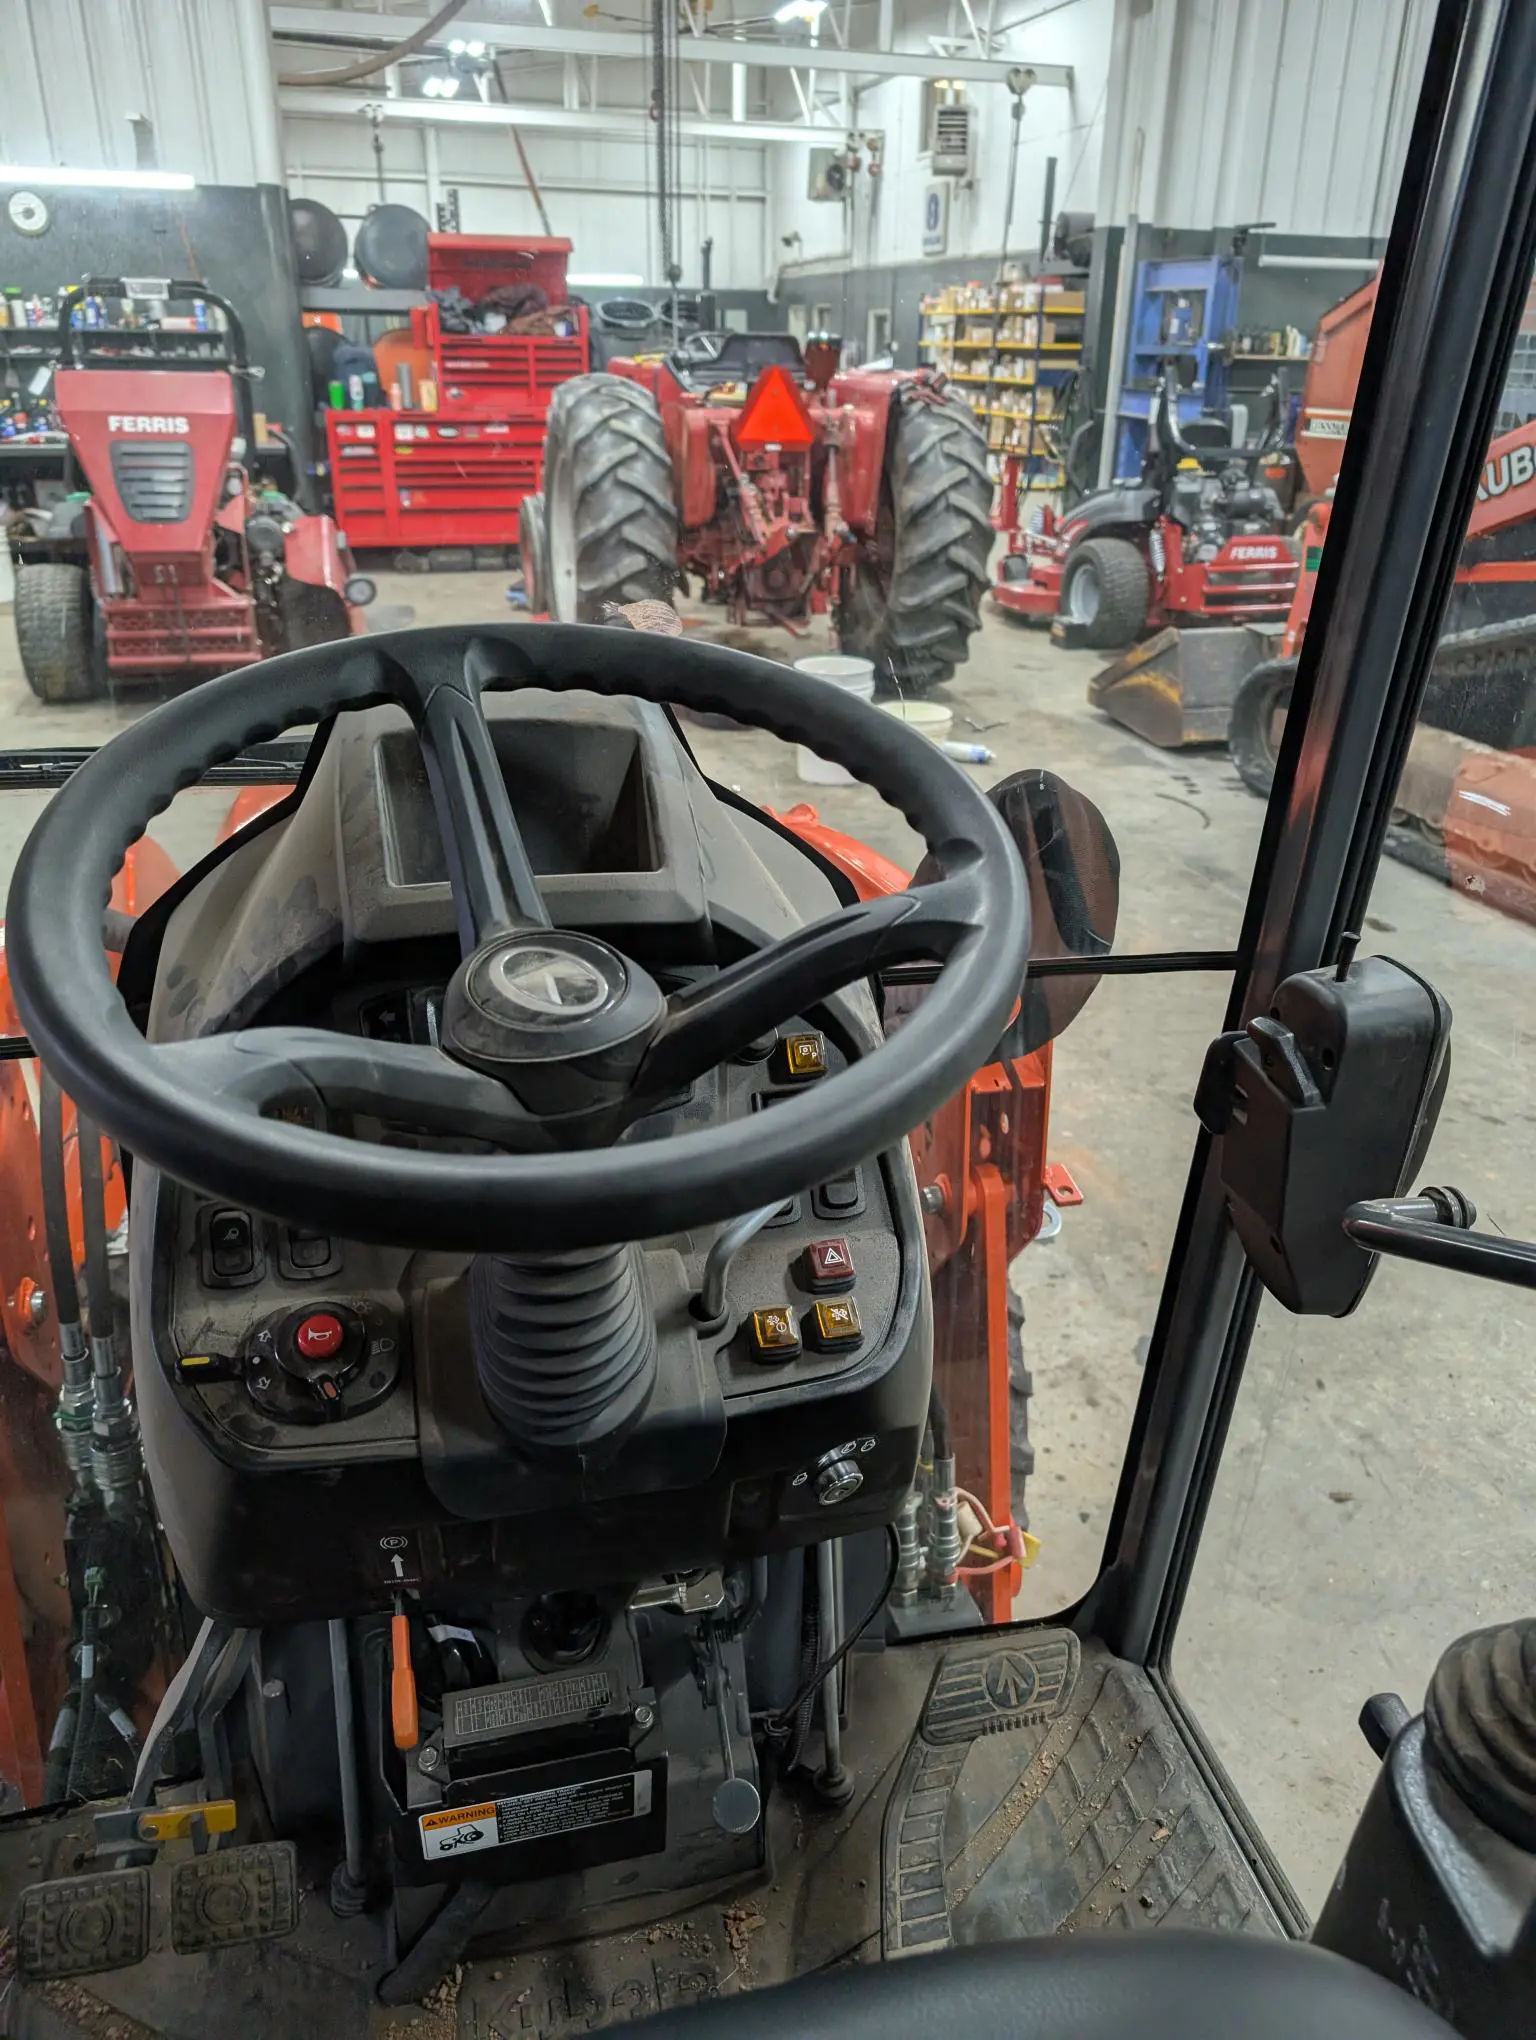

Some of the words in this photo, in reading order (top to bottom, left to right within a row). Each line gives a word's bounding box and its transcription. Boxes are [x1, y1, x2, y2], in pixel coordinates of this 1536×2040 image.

[108, 415, 190, 434] FERRIS
[1476, 445, 1536, 501] UB
[1229, 545, 1278, 561] FERRIS
[438, 1807, 495, 1825] WARNING
